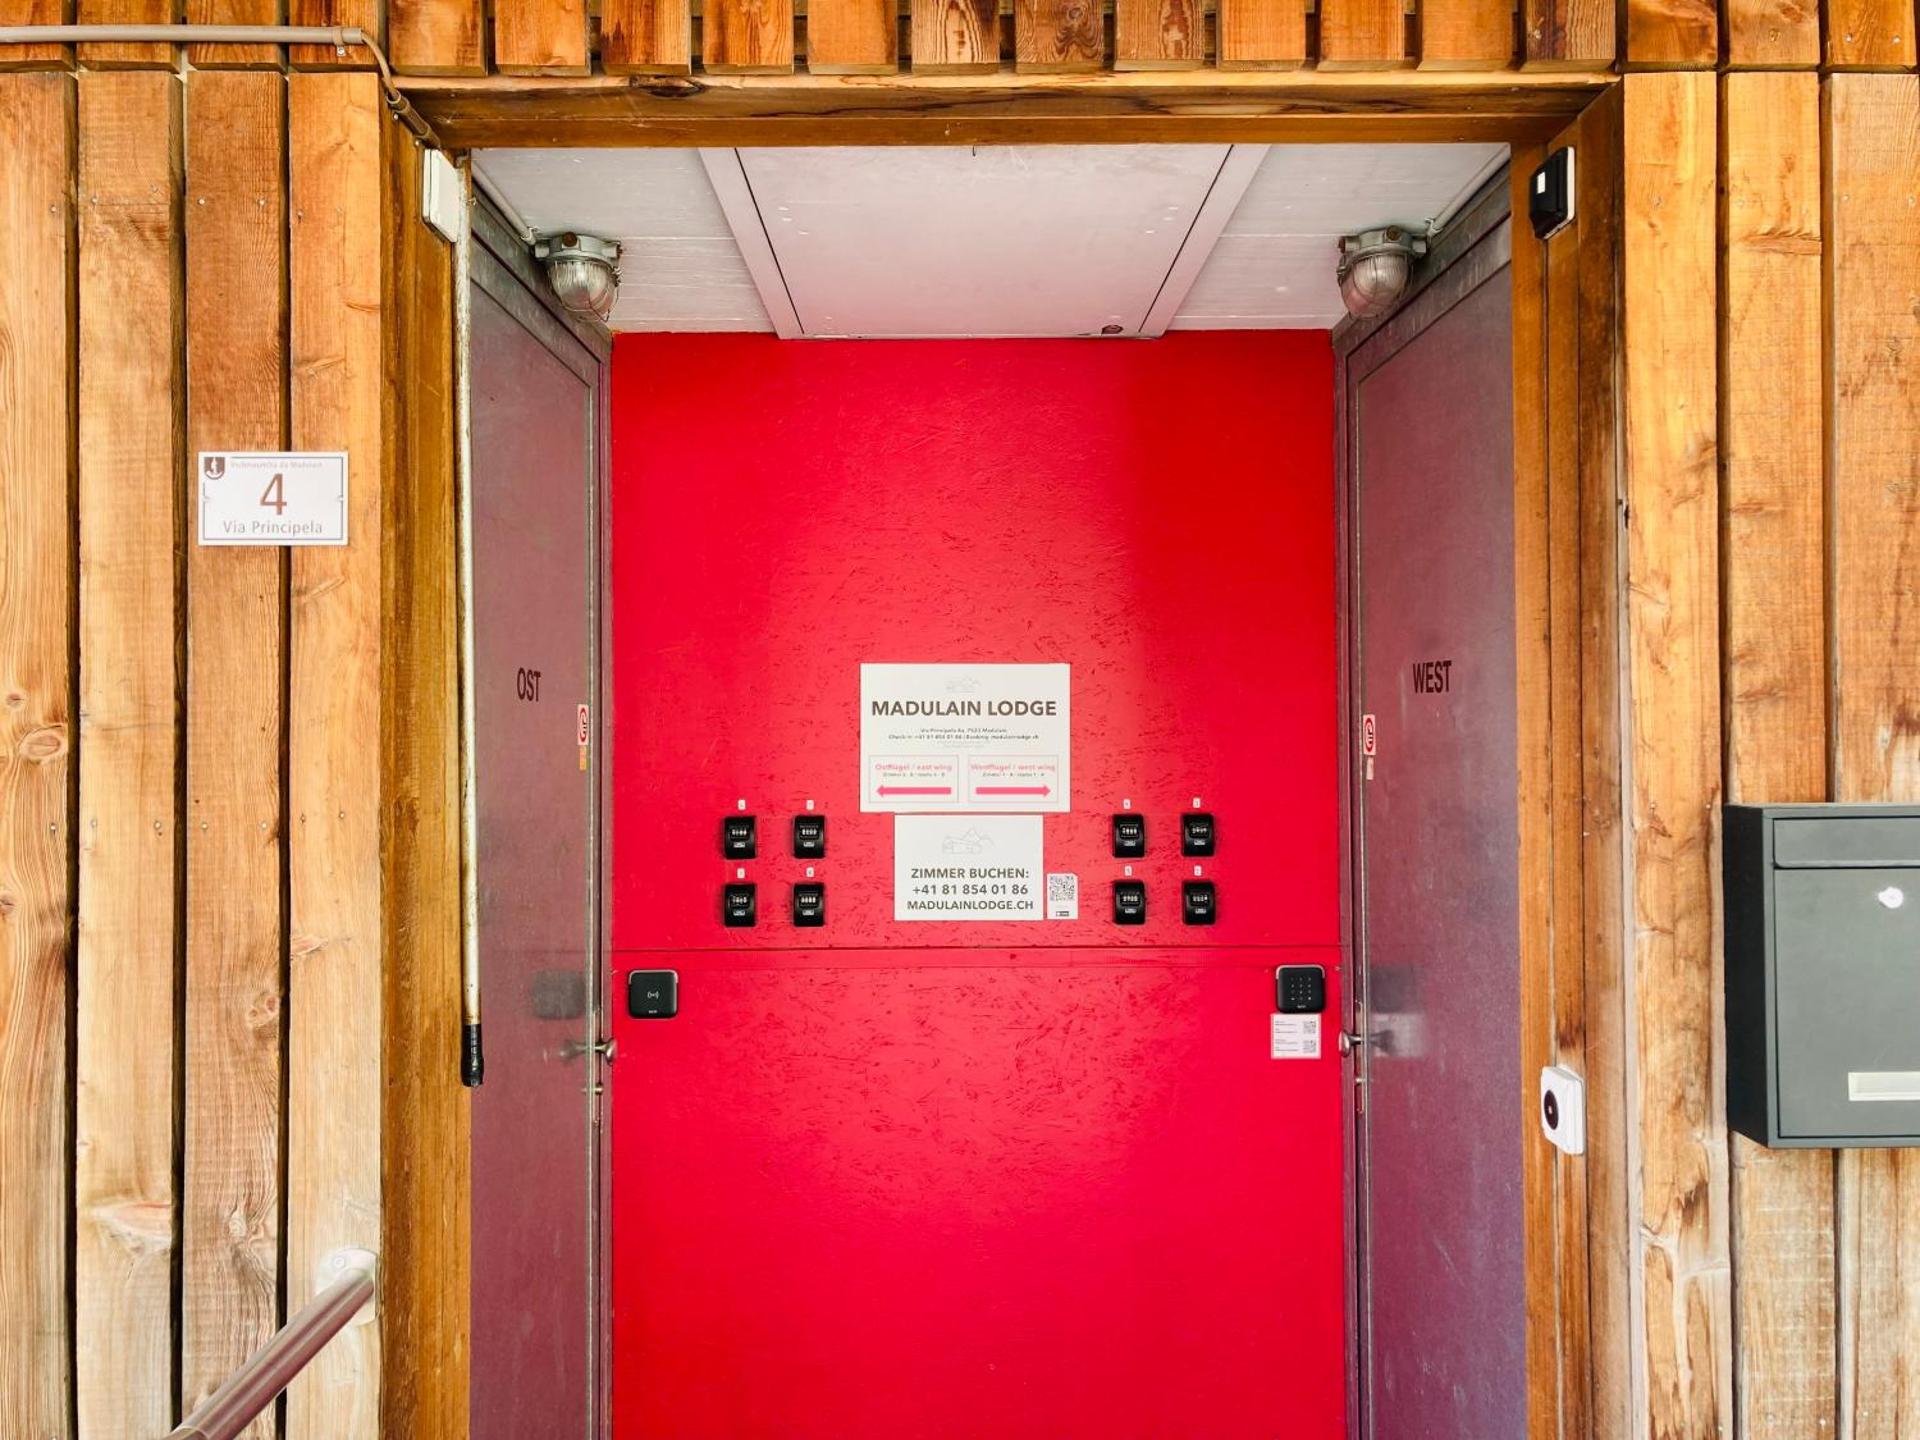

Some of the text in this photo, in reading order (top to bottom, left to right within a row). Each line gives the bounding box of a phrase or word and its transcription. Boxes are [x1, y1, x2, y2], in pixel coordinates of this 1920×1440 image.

[260, 473, 287, 515] 4
[223, 520, 323, 536] Via Principela
[516, 666, 541, 702] OST
[1412, 660, 1452, 694] WEST
[871, 700, 1057, 717] MADULAIN LODGE
[911, 868, 1029, 879] ZIMMER BUCHEN:
[912, 884, 1028, 895] +41 81 854 01 86
[907, 900, 1034, 910] MADULAINLODGE.CH
